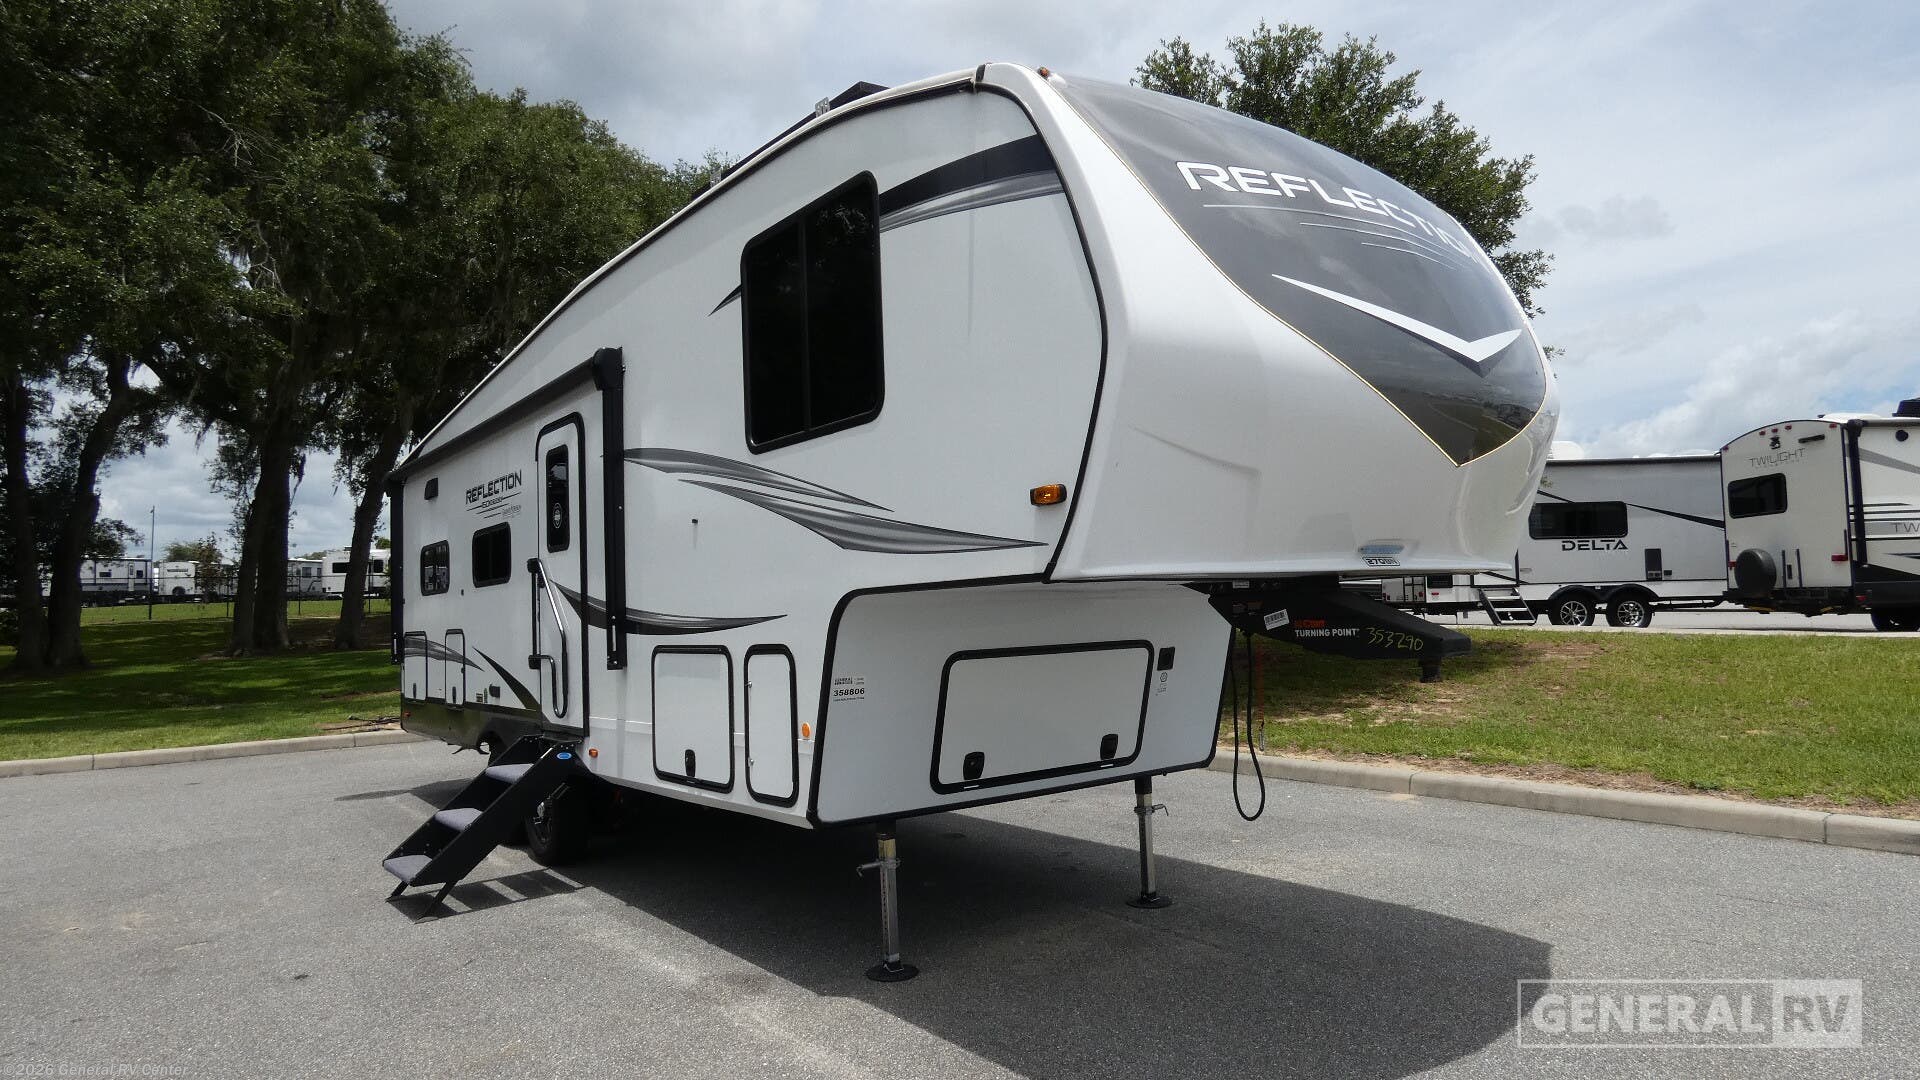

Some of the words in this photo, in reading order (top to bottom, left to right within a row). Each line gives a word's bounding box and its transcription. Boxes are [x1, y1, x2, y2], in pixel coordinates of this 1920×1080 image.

[1176, 161, 1490, 272] REFLECTION
[1748, 448, 1806, 467] TWILIGHT
[465, 469, 522, 505] REFLECTION
[1561, 539, 1629, 551] DELTA
[1294, 628, 1330, 638] TURNING
[1332, 628, 1358, 638] POINT
[1365, 626, 1424, 651] 353290
